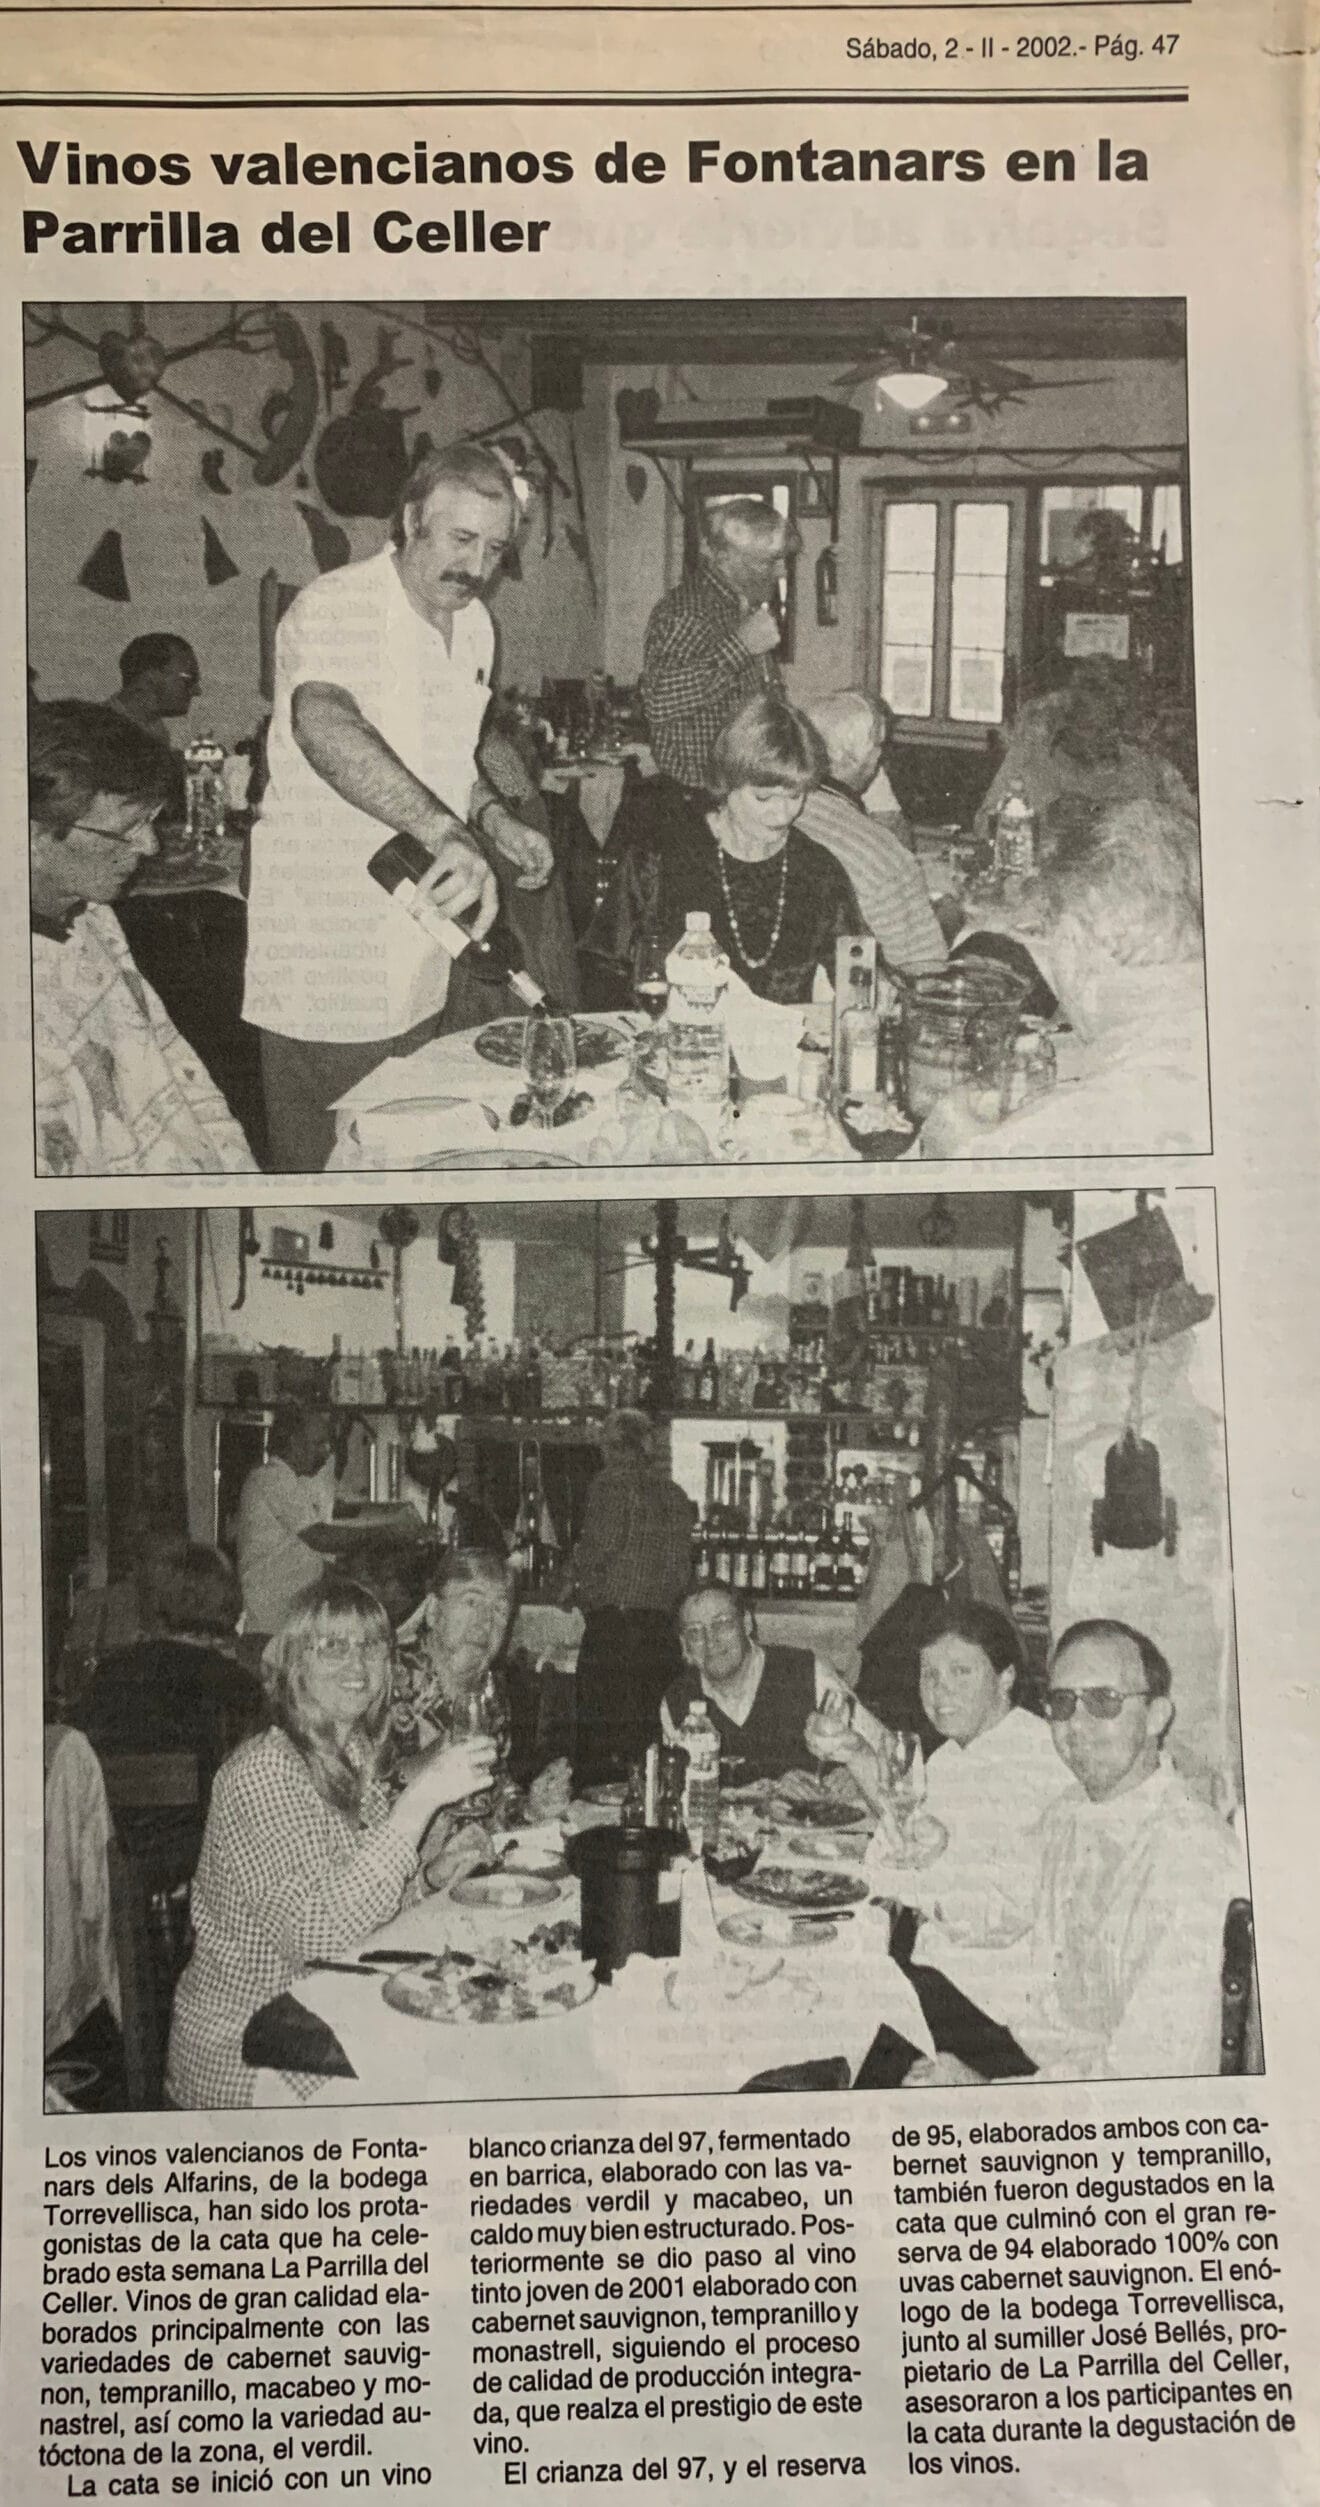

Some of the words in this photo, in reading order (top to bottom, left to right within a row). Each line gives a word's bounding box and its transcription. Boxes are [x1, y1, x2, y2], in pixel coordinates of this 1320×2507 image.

[847, 37, 936, 61] Sábado,
[945, 38, 958, 58] 2
[982, 37, 993, 58] II
[1095, 34, 1143, 61] Pág.
[1152, 34, 1179, 54] 47
[16, 141, 191, 185] Vinos
[210, 141, 574, 185] valencianos
[595, 141, 666, 184] de
[689, 139, 985, 183] Fontanars
[1006, 149, 1075, 182] en
[1099, 139, 1148, 181] la
[23, 210, 240, 254] Parrilla
[262, 211, 350, 254] del
[373, 210, 551, 253] Celler
[470, 2137, 546, 2159] blanco
[551, 2134, 635, 2156] crianza
[639, 2131, 673, 2153] del
[678, 2131, 713, 2155] 97,
[718, 2127, 850, 2151] fermentado
[892, 2126, 920, 2147] de
[927, 2125, 961, 2148] 95,
[969, 2120, 1097, 2144] elaborados
[1103, 2117, 1179, 2139] ambos
[1186, 2118, 1226, 2136] con
[1233, 2117, 1269, 2134] ca-
[45, 2147, 86, 2168] Los
[96, 2145, 157, 2166] vinos
[166, 2141, 303, 2164] valencianos
[314, 2139, 342, 2161] de
[353, 2138, 427, 2159] Fonta-
[471, 2193, 571, 2217] riedades
[586, 2189, 649, 2212] verdil
[664, 2194, 678, 2216] y
[694, 2186, 808, 2210] macabeo,
[825, 2189, 852, 2206] un
[894, 2180, 986, 2205] también
[994, 2179, 1068, 2201] fueron
[1076, 2173, 1209, 2203] degustados
[1217, 2176, 1246, 2193] en
[1254, 2170, 1275, 2192] la
[43, 2201, 199, 2226] Torrevellisca,
[209, 2199, 251, 2221] han
[261, 2198, 309, 2220] sido
[318, 2197, 350, 2218] los
[360, 2196, 428, 2223] prota-
[470, 2222, 533, 2246] caldo
[538, 2225, 587, 2248] muy
[591, 2219, 639, 2241] bien
[644, 2215, 795, 2240] estructurado.
[801, 2214, 854, 2235] Pos-
[898, 2245, 962, 2264] serva
[969, 2239, 997, 2261] de
[1005, 2238, 1034, 2260] 94
[1041, 2233, 1156, 2258] elaborado
[1165, 2230, 1229, 2253] 100%
[1237, 2233, 1278, 2251] con
[43, 2262, 110, 2285] brado
[117, 2261, 166, 2282] esta
[172, 2262, 265, 2281] semana
[272, 2257, 300, 2278] La
[307, 2254, 388, 2278] Parrilla
[394, 2252, 428, 2275] del
[471, 2250, 604, 2275] teriormente
[617, 2253, 644, 2270] se
[658, 2247, 692, 2269] dio
[705, 2249, 761, 2273] paso
[775, 2243, 794, 2265] al
[807, 2242, 856, 2264] vino
[900, 2275, 954, 2293] uvas
[961, 2267, 1063, 2291] cabernet
[1069, 2263, 1193, 2291] sauvignon.
[1201, 2259, 1223, 2282] El
[1230, 2257, 1281, 2281] enó-
[43, 2291, 117, 2314] Celler.
[126, 2289, 191, 2312] Vinos
[199, 2288, 227, 2310] de
[235, 2291, 286, 2315] gran
[294, 2283, 377, 2308] calidad
[386, 2282, 429, 2304] ela-
[42, 2320, 137, 2344] borados
[152, 2317, 324, 2347] principalmente
[339, 2318, 380, 2336] con
[397, 2312, 429, 2334] las
[472, 2310, 575, 2334] cabernet
[580, 2306, 706, 2334] sauvignon,
[711, 2301, 841, 2330] tempranillo
[845, 2305, 859, 2328] y
[902, 2331, 959, 2359] junto
[967, 2328, 986, 2351] al
[995, 2326, 1085, 2350] sumiller
[1092, 2322, 1147, 2346] José
[1155, 2319, 1232, 2345] Bellés,
[1240, 2323, 1287, 2346] pro-
[41, 2350, 170, 2374] variedades
[185, 2348, 213, 2371] de
[227, 2346, 331, 2370] cabernet
[344, 2341, 430, 2369] sauvig-
[904, 2359, 991, 2389] pietario
[1001, 2358, 1029, 2380] de
[1040, 2356, 1069, 2378] La
[1079, 2353, 1160, 2377] Parrilla
[1169, 2350, 1203, 2373] del
[1214, 2348, 1289, 2373] Celler,
[41, 2387, 90, 2408] non,
[99, 2378, 236, 2409] tempranillo,
[246, 2375, 355, 2400] macabeo
[363, 2378, 377, 2401] y
[385, 2376, 430, 2394] mo-
[473, 2371, 502, 2394] de
[509, 2367, 592, 2392] calidad
[600, 2367, 628, 2389] de
[636, 2362, 764, 2394] producción
[772, 2362, 861, 2389] integra-
[905, 2392, 1038, 2413] asesoraron
[1046, 2391, 1060, 2409] a
[1067, 2386, 1100, 2408] los
[1107, 2381, 1256, 2412] participantes
[1264, 2383, 1292, 2402] en
[40, 2412, 125, 2438] nastrel,
[135, 2410, 171, 2434] así
[178, 2413, 243, 2433] como
[253, 2407, 273, 2430] la
[281, 2402, 383, 2429] variedad
[393, 2406, 431, 2424] au-
[39, 2443, 125, 2467] tóctona
[134, 2442, 162, 2465] de
[171, 2441, 192, 2463] la
[199, 2443, 264, 2464] zona,
[273, 2436, 293, 2460] el
[301, 2433, 372, 2458] verdil.
[473, 2432, 529, 2454] vino.
[505, 2461, 526, 2485] El
[537, 2460, 623, 2484] crianza
[632, 2457, 667, 2481] del
[678, 2456, 713, 2482] 97,
[723, 2460, 737, 2484] y
[747, 2454, 767, 2478] el
[778, 2457, 866, 2477] reserva
[908, 2452, 943, 2474] los
[950, 2451, 1020, 2474] vinos.
[68, 2474, 97, 2497] La
[109, 2474, 160, 2496] cata
[172, 2476, 199, 2494] se
[212, 2468, 273, 2493] inició
[285, 2471, 328, 2490] con
[341, 2469, 370, 2488] un
[382, 2462, 431, 2486] vino
